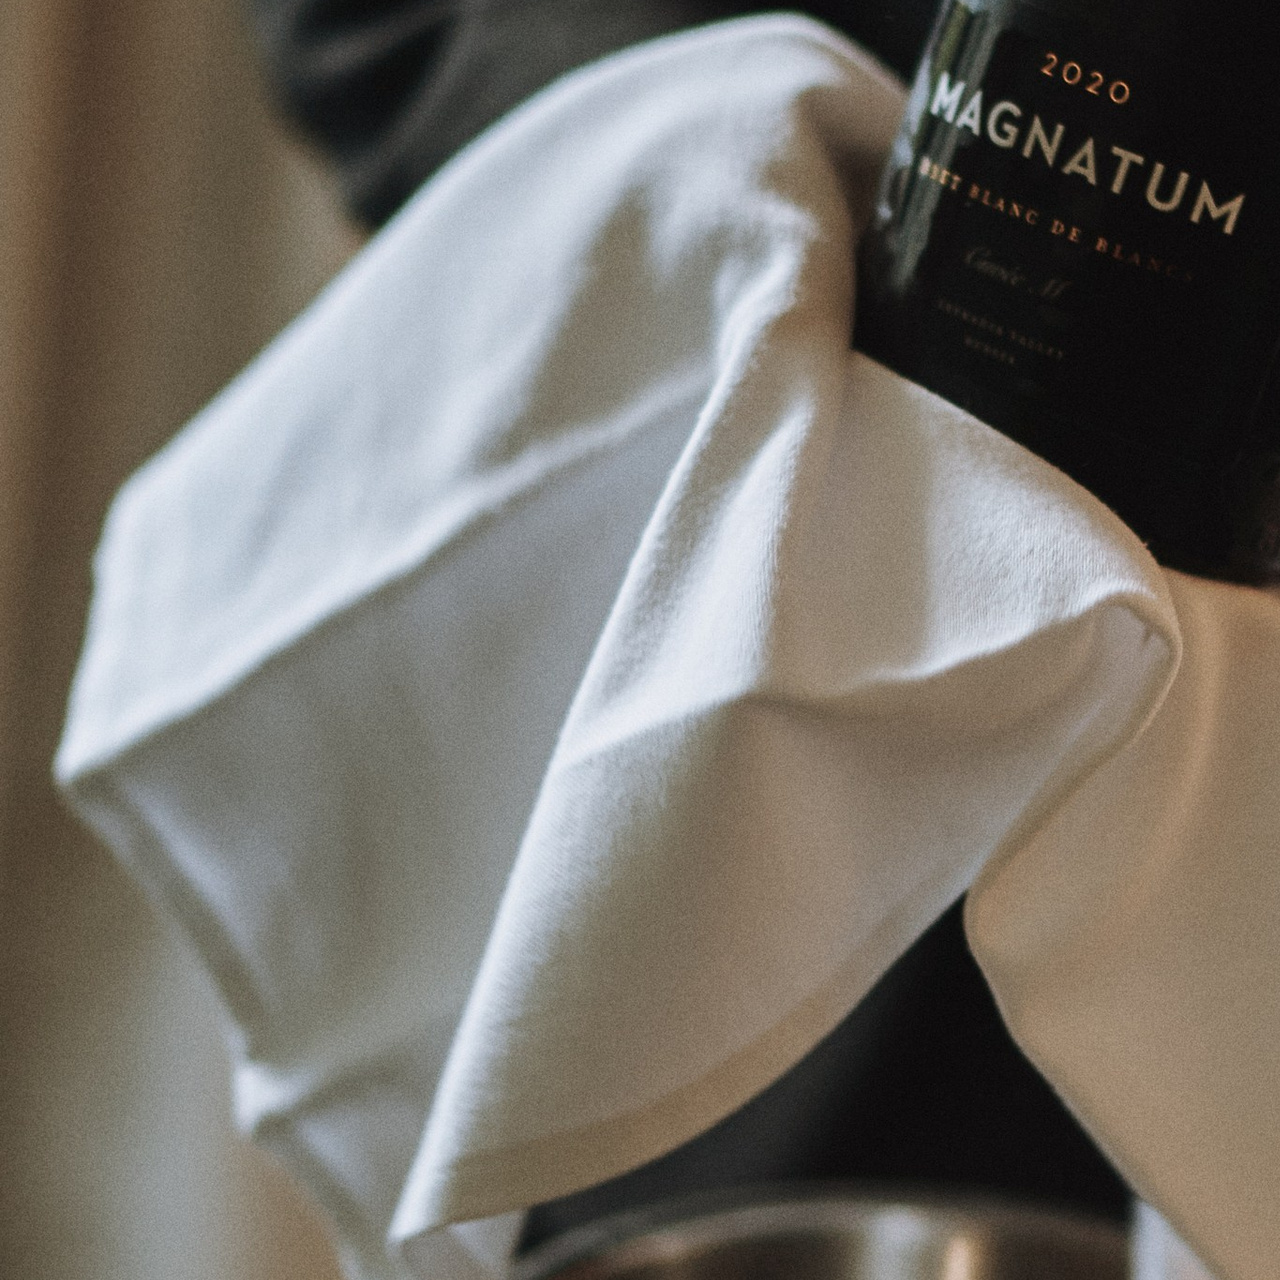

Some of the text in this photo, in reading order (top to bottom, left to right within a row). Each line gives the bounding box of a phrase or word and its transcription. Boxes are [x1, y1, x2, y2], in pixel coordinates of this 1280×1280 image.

[1040, 50, 1132, 106] 2020
[929, 70, 1248, 236] MAGNATUM
[968, 183, 1039, 226] BLANC
[1050, 218, 1082, 245] DE
